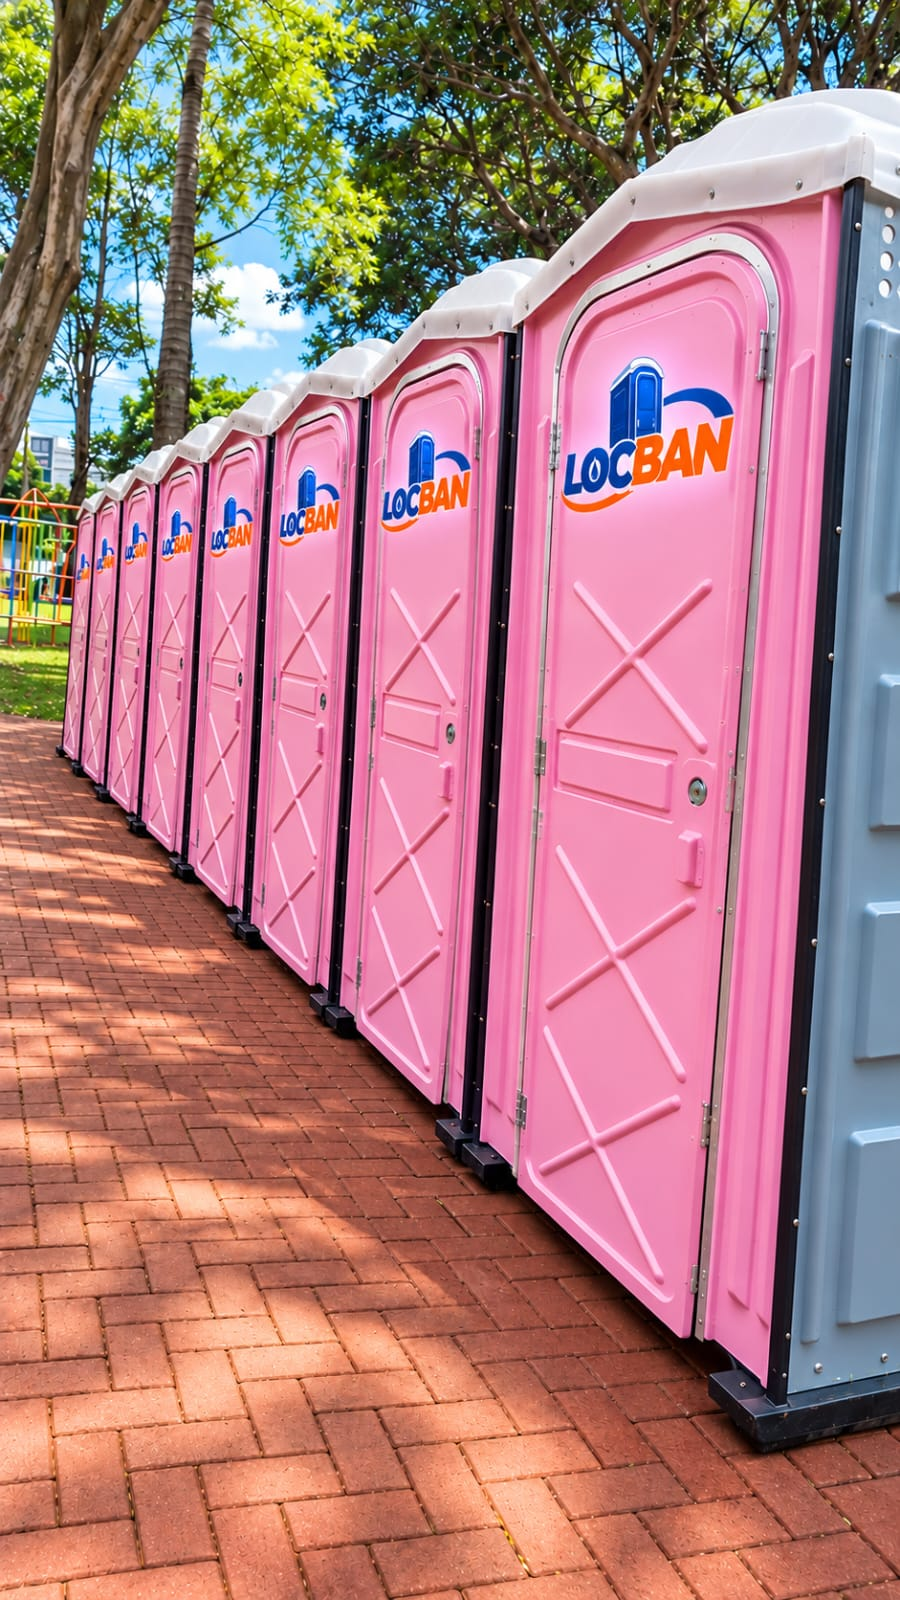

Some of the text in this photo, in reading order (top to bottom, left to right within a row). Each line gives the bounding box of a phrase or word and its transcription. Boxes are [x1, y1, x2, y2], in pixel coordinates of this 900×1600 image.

[563, 417, 734, 496] LOCBAN
[382, 471, 470, 521] LOCBAN
[211, 523, 252, 550] LOCBAN
[280, 502, 339, 538] LOCBAN
[162, 534, 192, 556] LOCBAN
